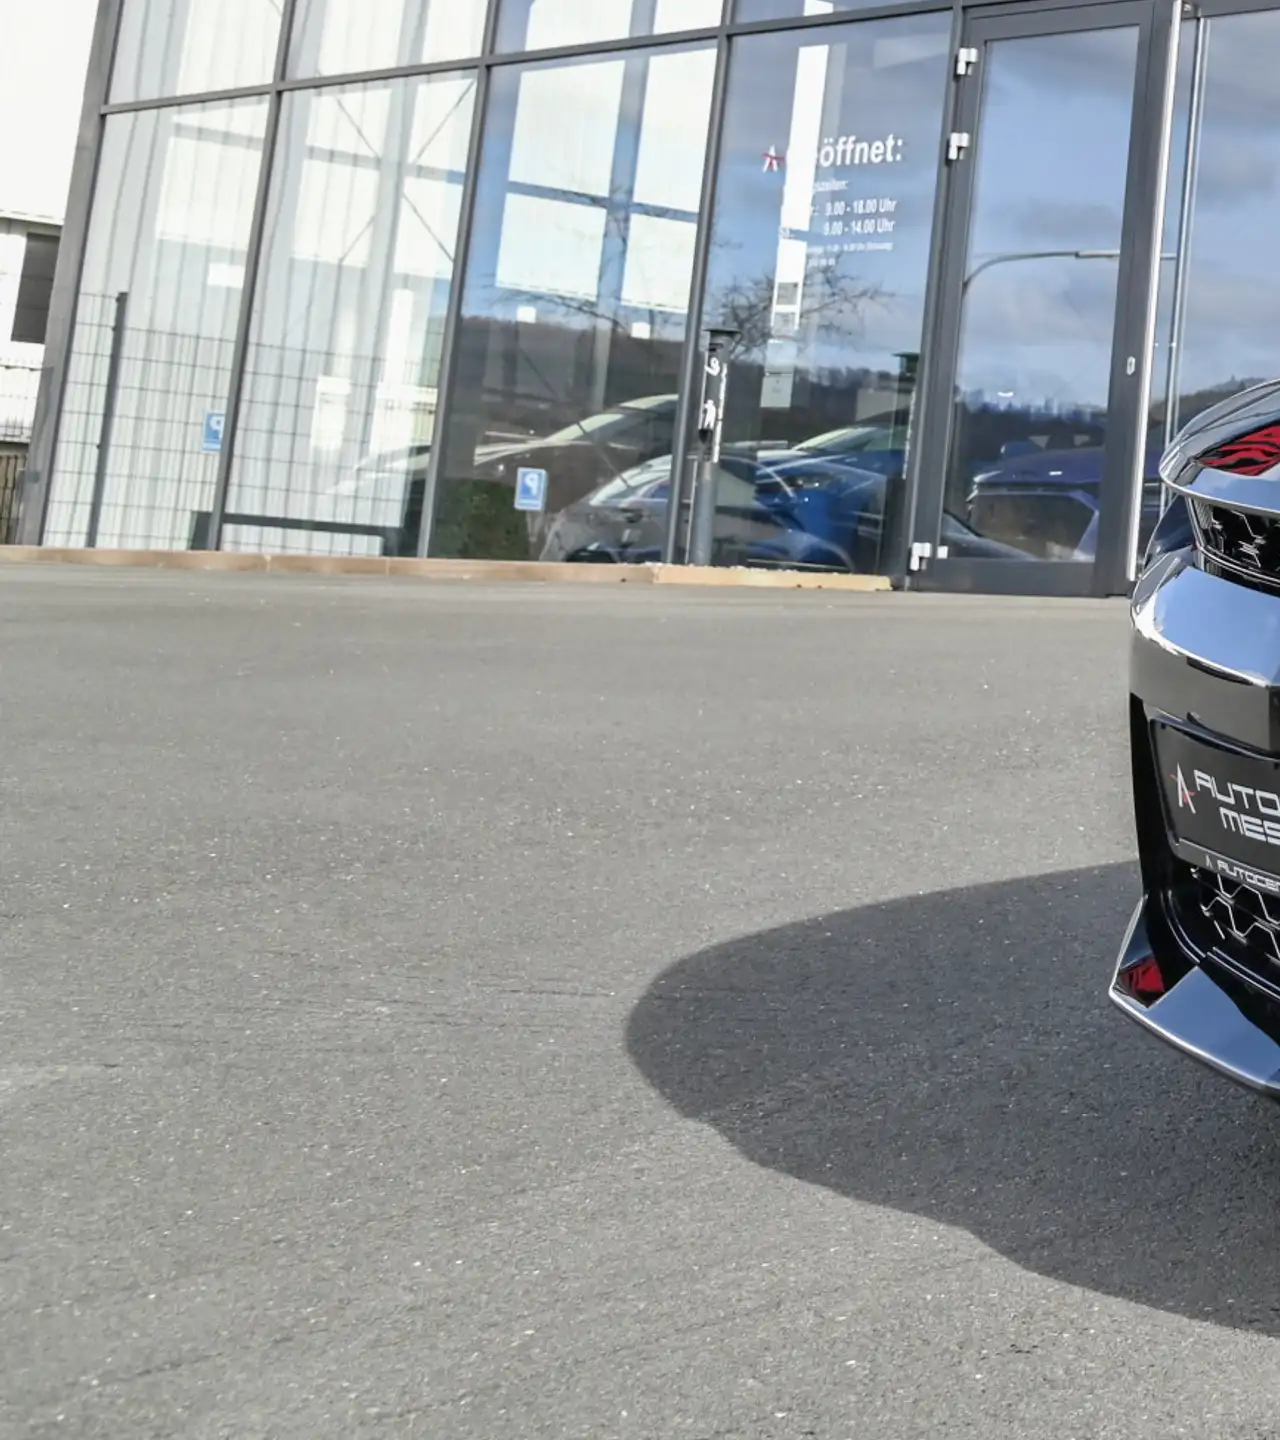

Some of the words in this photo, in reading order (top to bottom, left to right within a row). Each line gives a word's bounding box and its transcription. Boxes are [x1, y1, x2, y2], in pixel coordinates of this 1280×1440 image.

[817, 133, 903, 168] öffnet:
[879, 197, 897, 212] Uhr
[877, 217, 896, 233] Uhr
